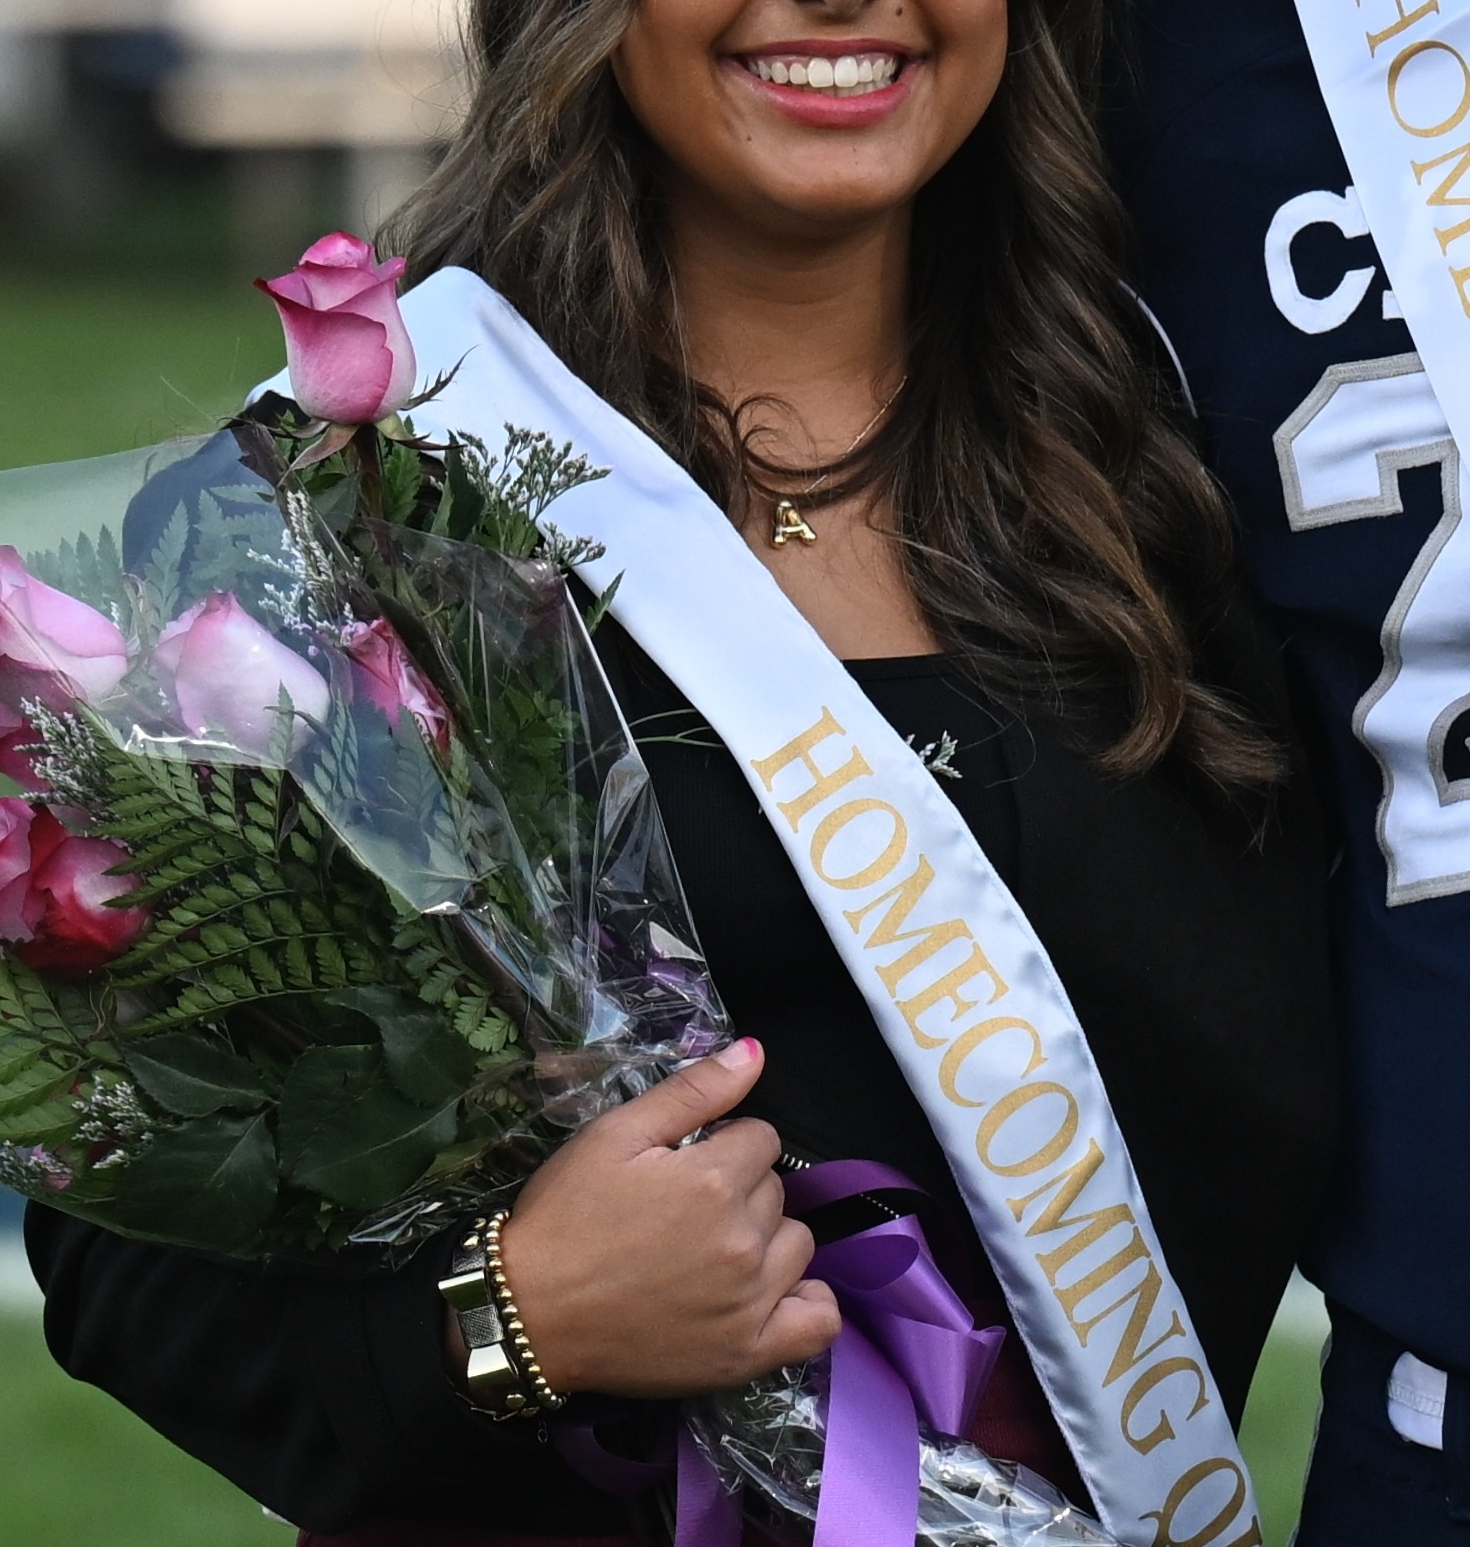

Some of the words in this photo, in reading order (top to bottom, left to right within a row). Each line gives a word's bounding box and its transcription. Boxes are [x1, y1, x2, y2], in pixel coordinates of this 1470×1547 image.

[774, 499, 817, 545] A
[749, 705, 1211, 1456] HOMECOMING
[1137, 1456, 1263, 1547] Q
